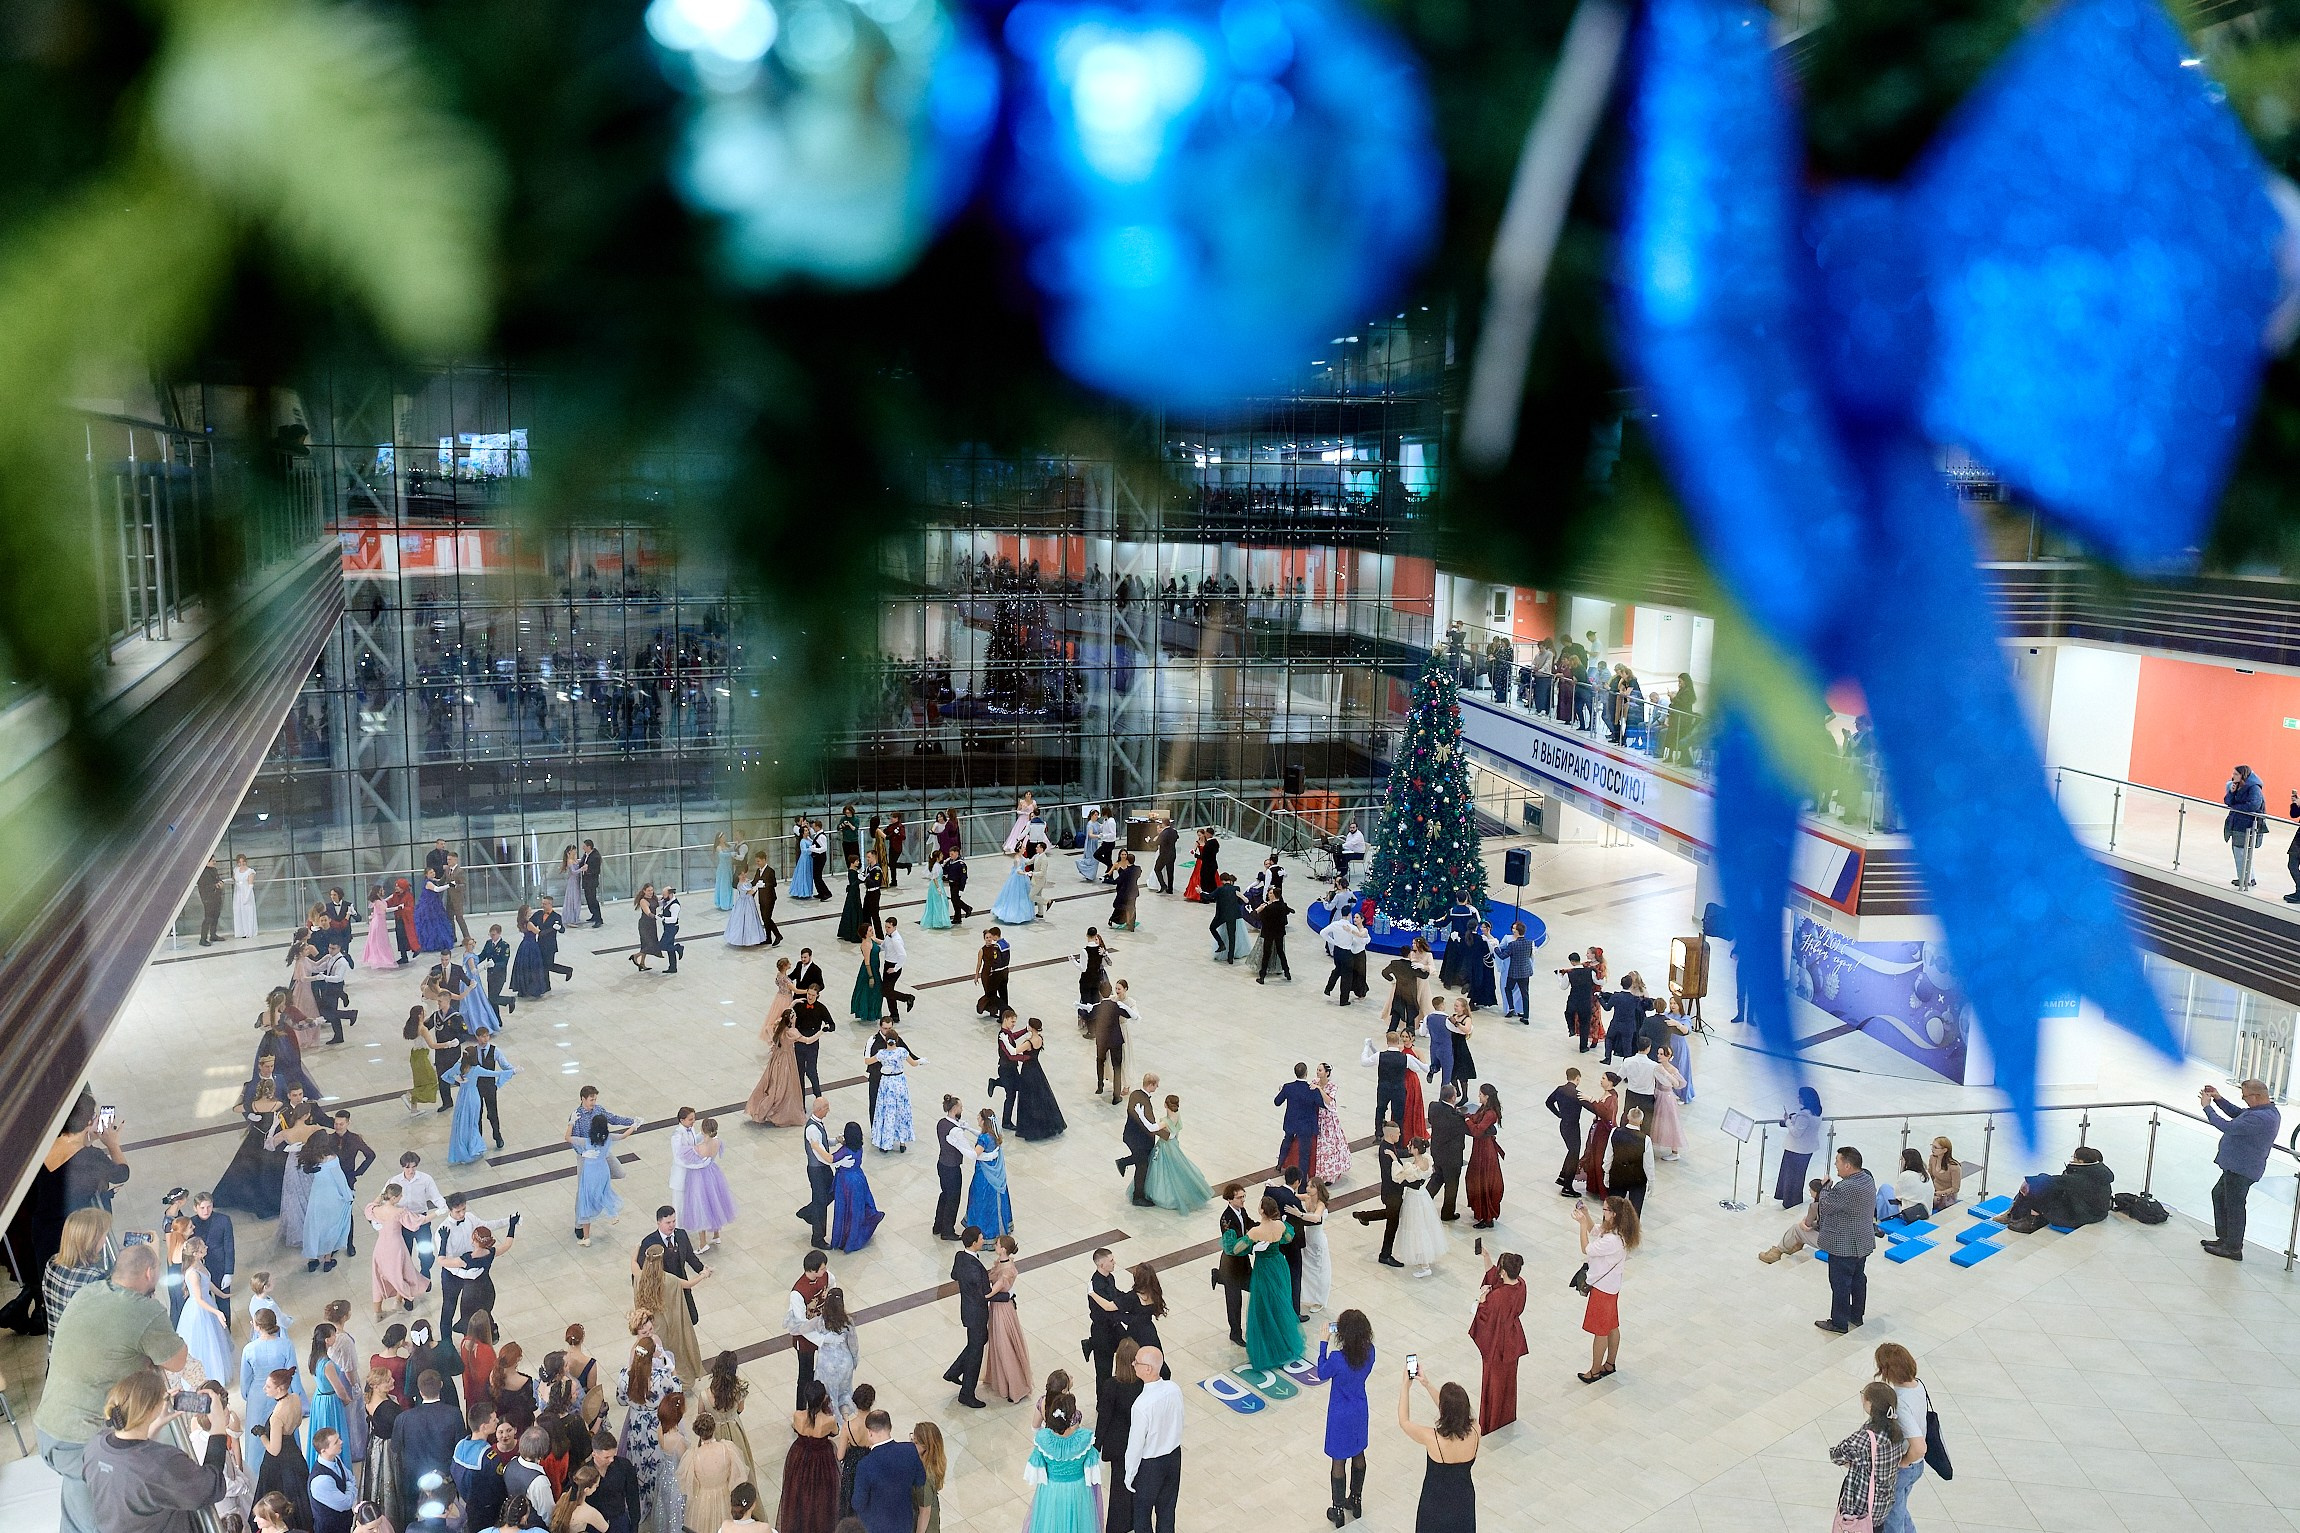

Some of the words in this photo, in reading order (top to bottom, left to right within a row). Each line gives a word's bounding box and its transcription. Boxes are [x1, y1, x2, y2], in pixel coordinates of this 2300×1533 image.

[1531, 738, 1539, 760] Я
[1540, 741, 1591, 781] ВЫБИРАЮ
[1592, 762, 1646, 806] РОССИЮ!
[2041, 999, 2077, 1009] АМПУС
